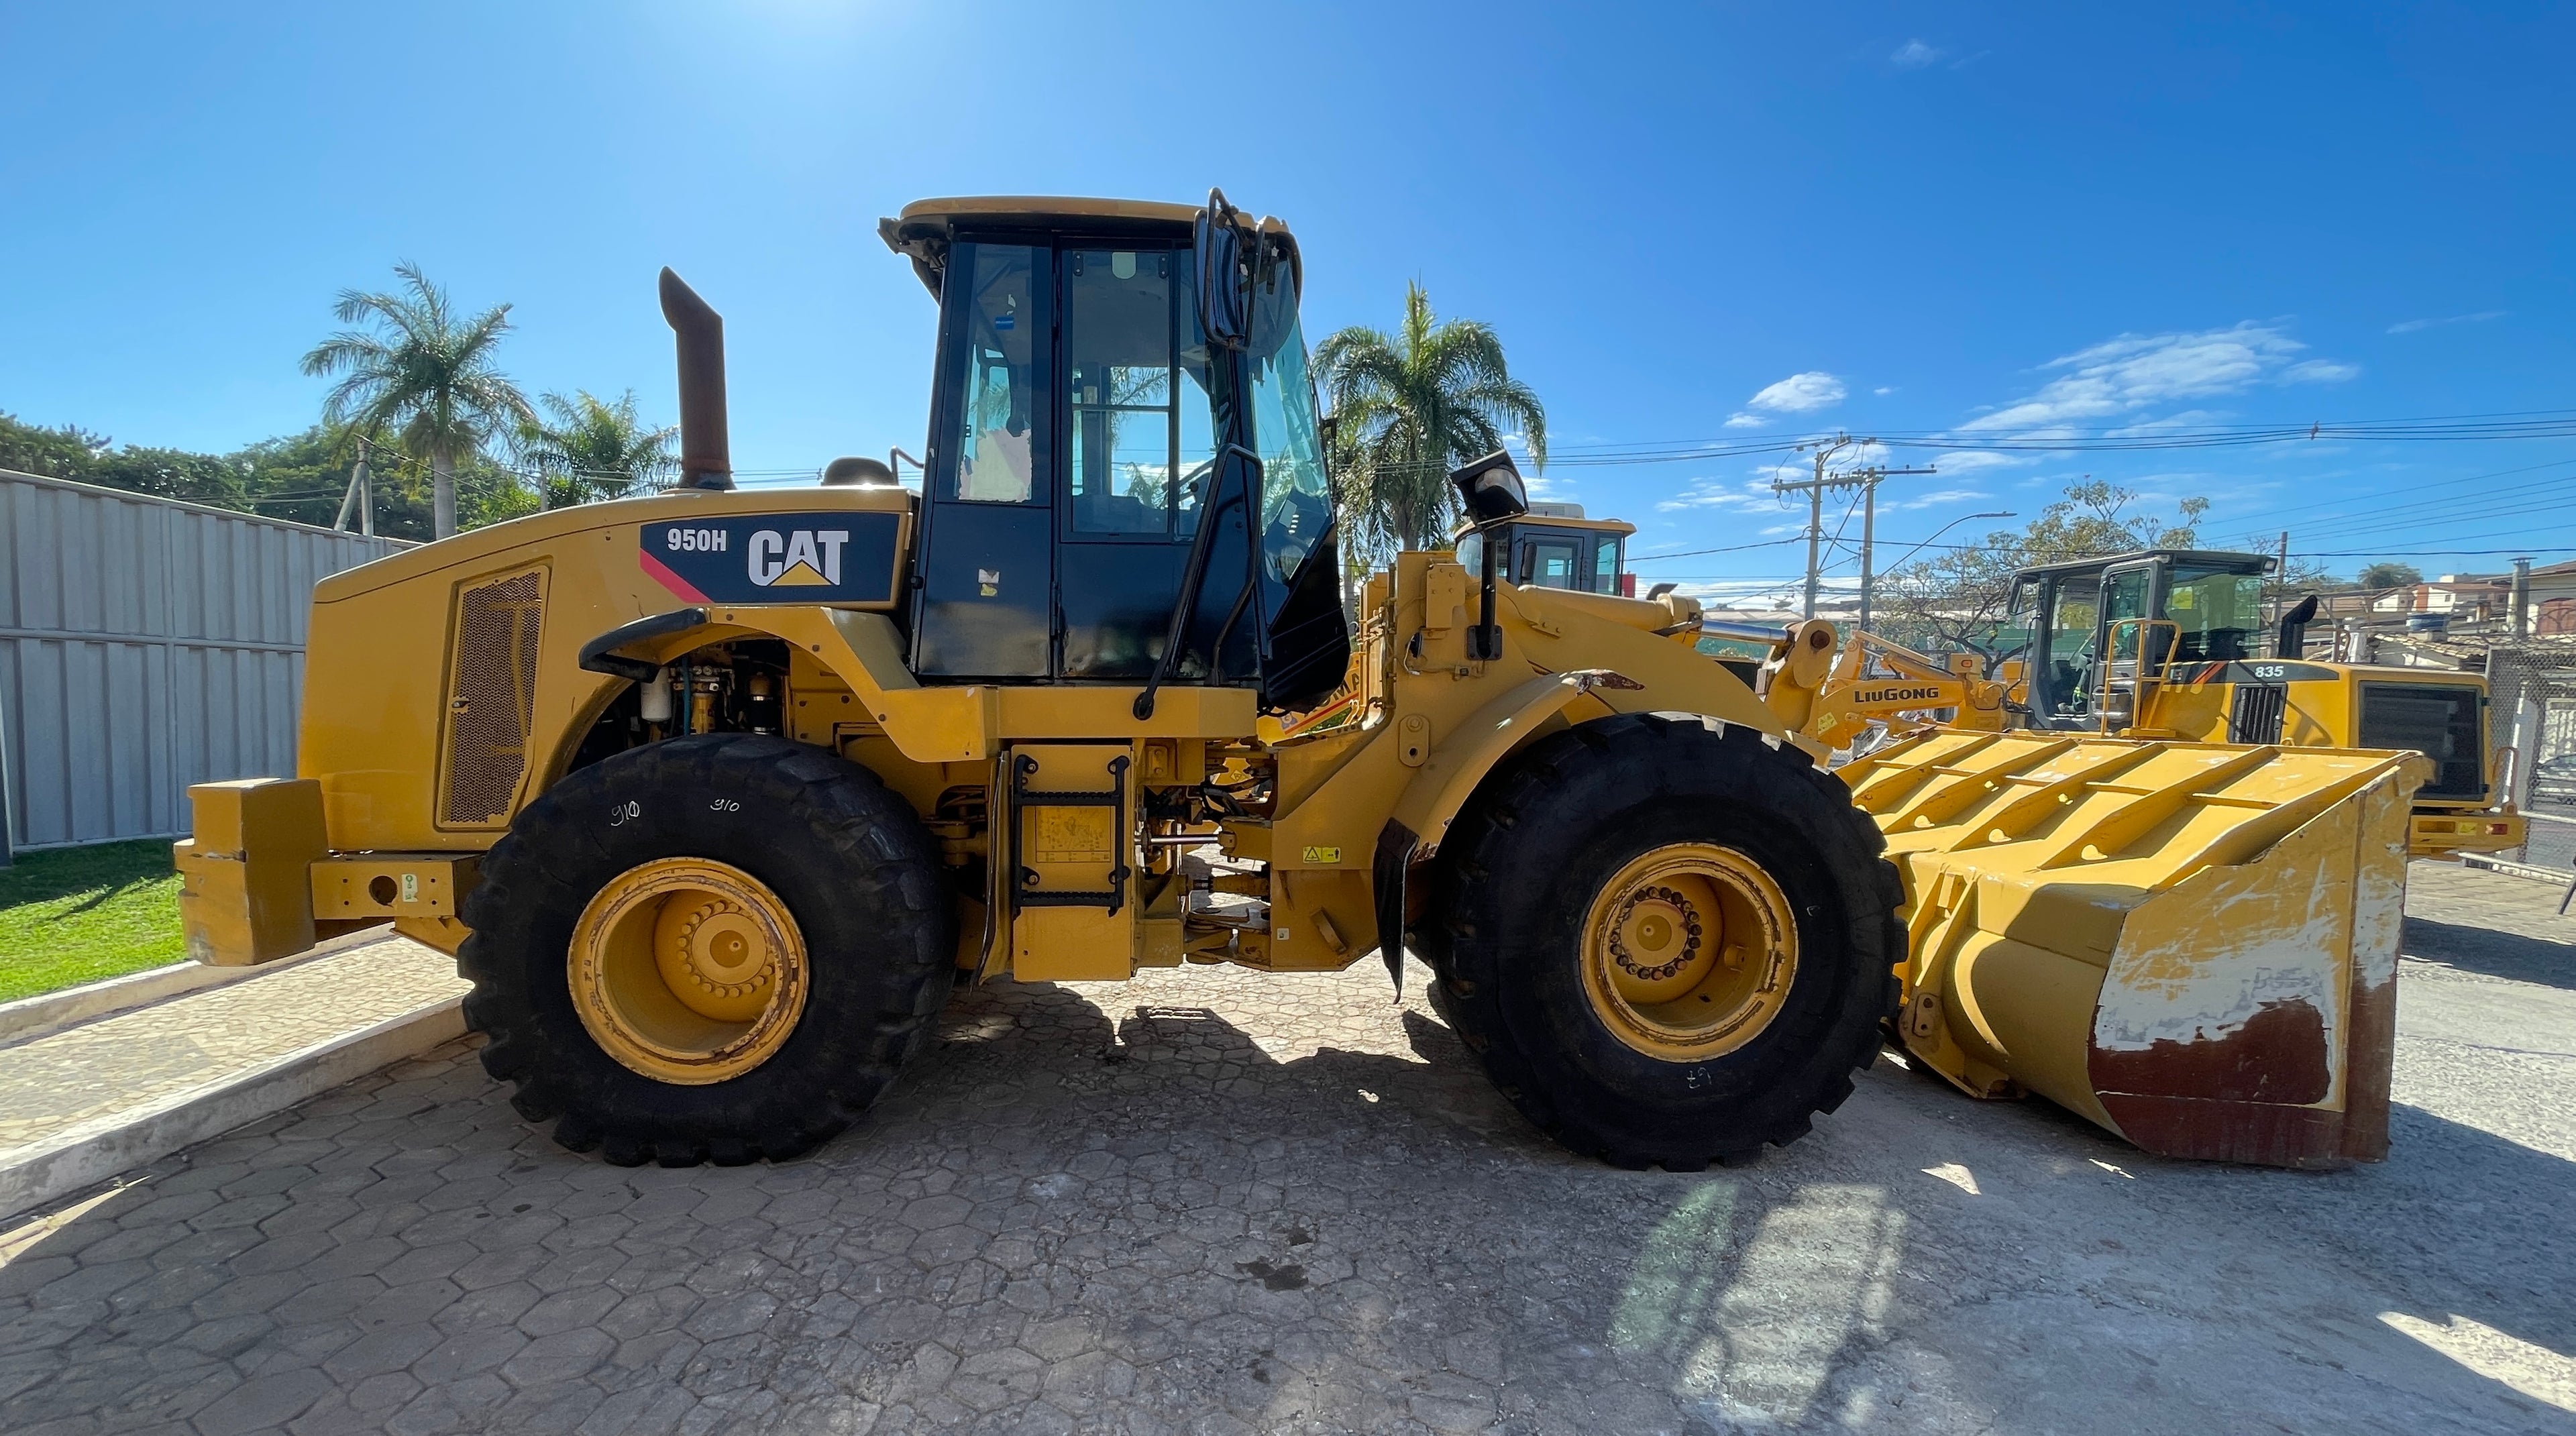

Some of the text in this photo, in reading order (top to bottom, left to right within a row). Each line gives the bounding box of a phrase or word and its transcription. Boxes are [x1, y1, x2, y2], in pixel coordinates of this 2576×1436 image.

[667, 529, 727, 551] 950H
[748, 530, 849, 586] CAT
[2255, 666, 2284, 677] 835
[710, 799, 739, 812] 910
